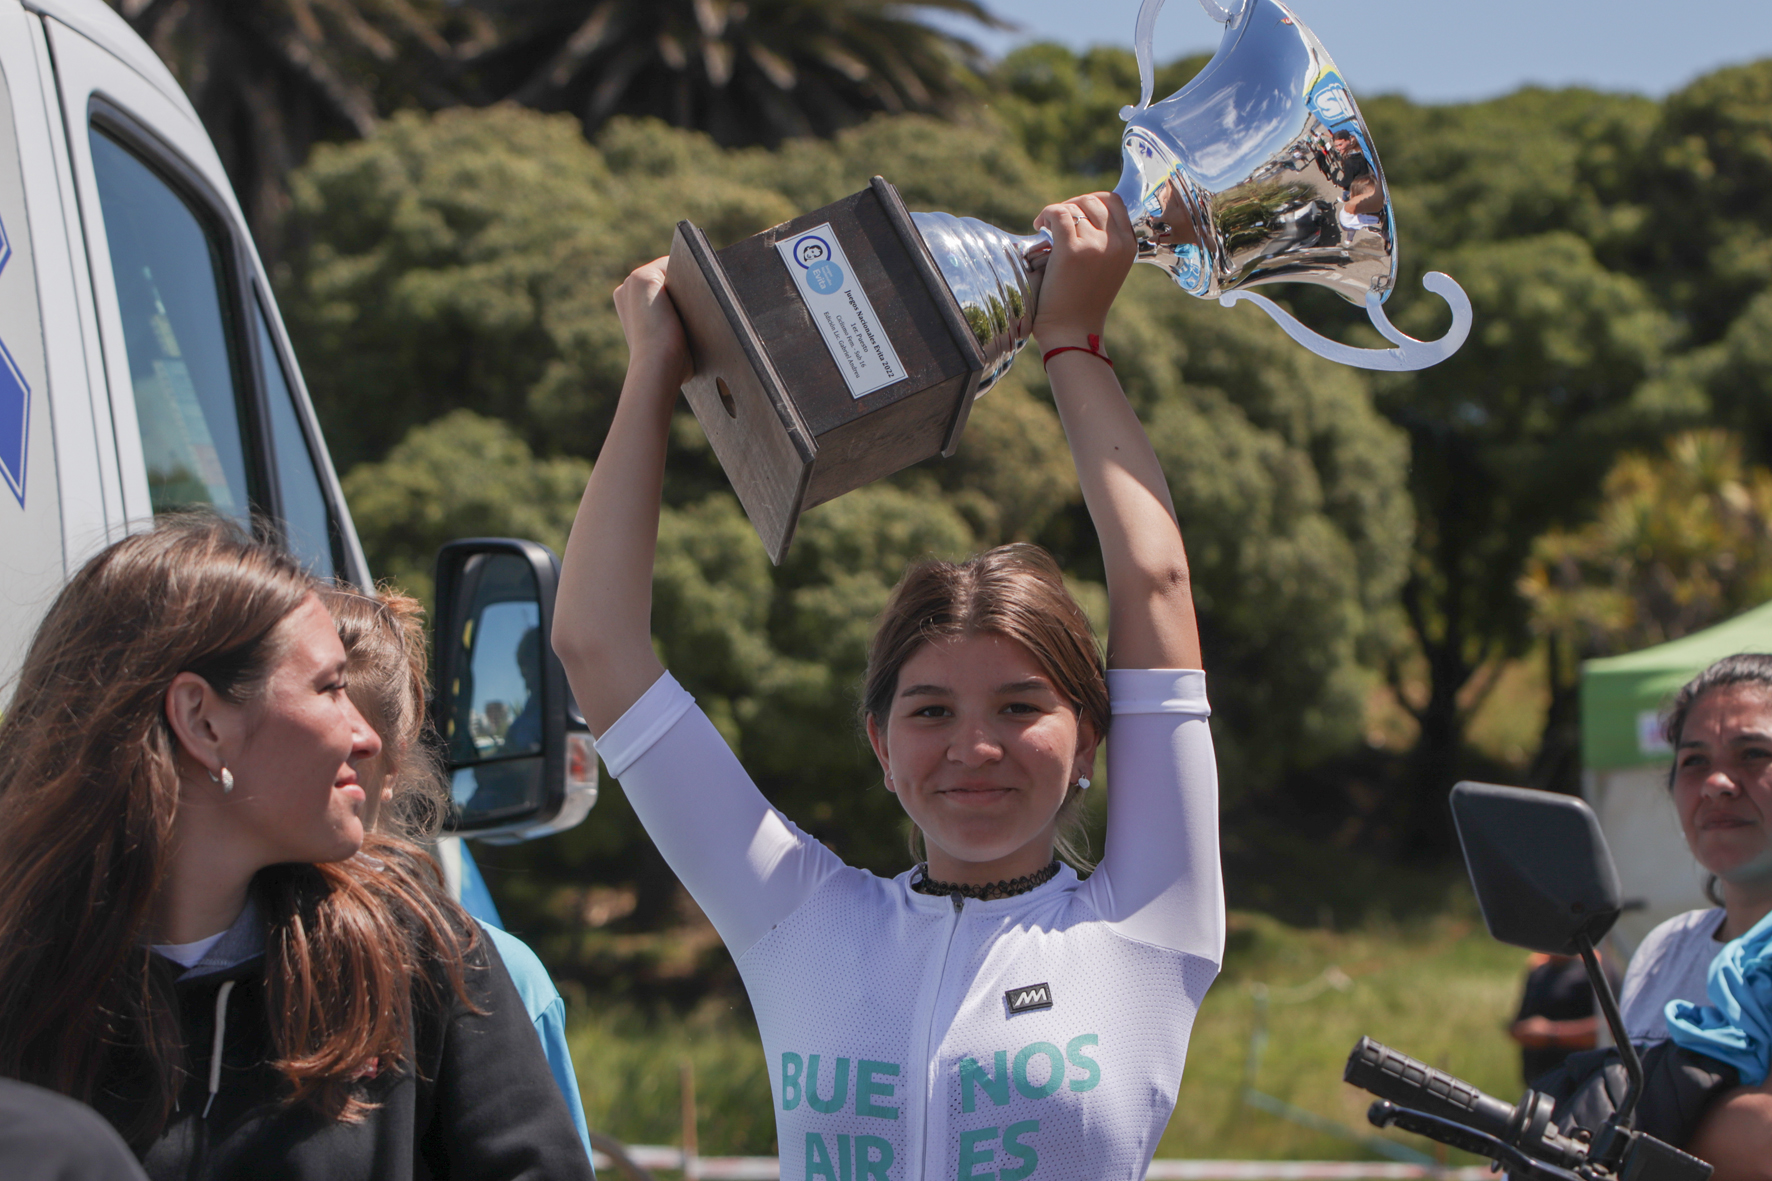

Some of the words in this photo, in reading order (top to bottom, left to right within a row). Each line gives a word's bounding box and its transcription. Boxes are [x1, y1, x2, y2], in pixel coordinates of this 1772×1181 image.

[813, 269, 826, 290] Evita
[823, 311, 836, 332] Edición
[838, 340, 851, 360] Gabriel
[848, 358, 860, 379] Andreu
[836, 315, 849, 336] Ciclismo
[853, 350, 862, 362] Sub
[859, 360, 867, 369] 16
[844, 289, 859, 311] Juegos
[856, 310, 876, 345] Nacionales
[873, 344, 885, 362] Evita
[882, 361, 895, 378] 2022
[857, 333, 869, 353] Puesto
[781, 1051, 900, 1120] BUE
[959, 1033, 1101, 1114] NOS
